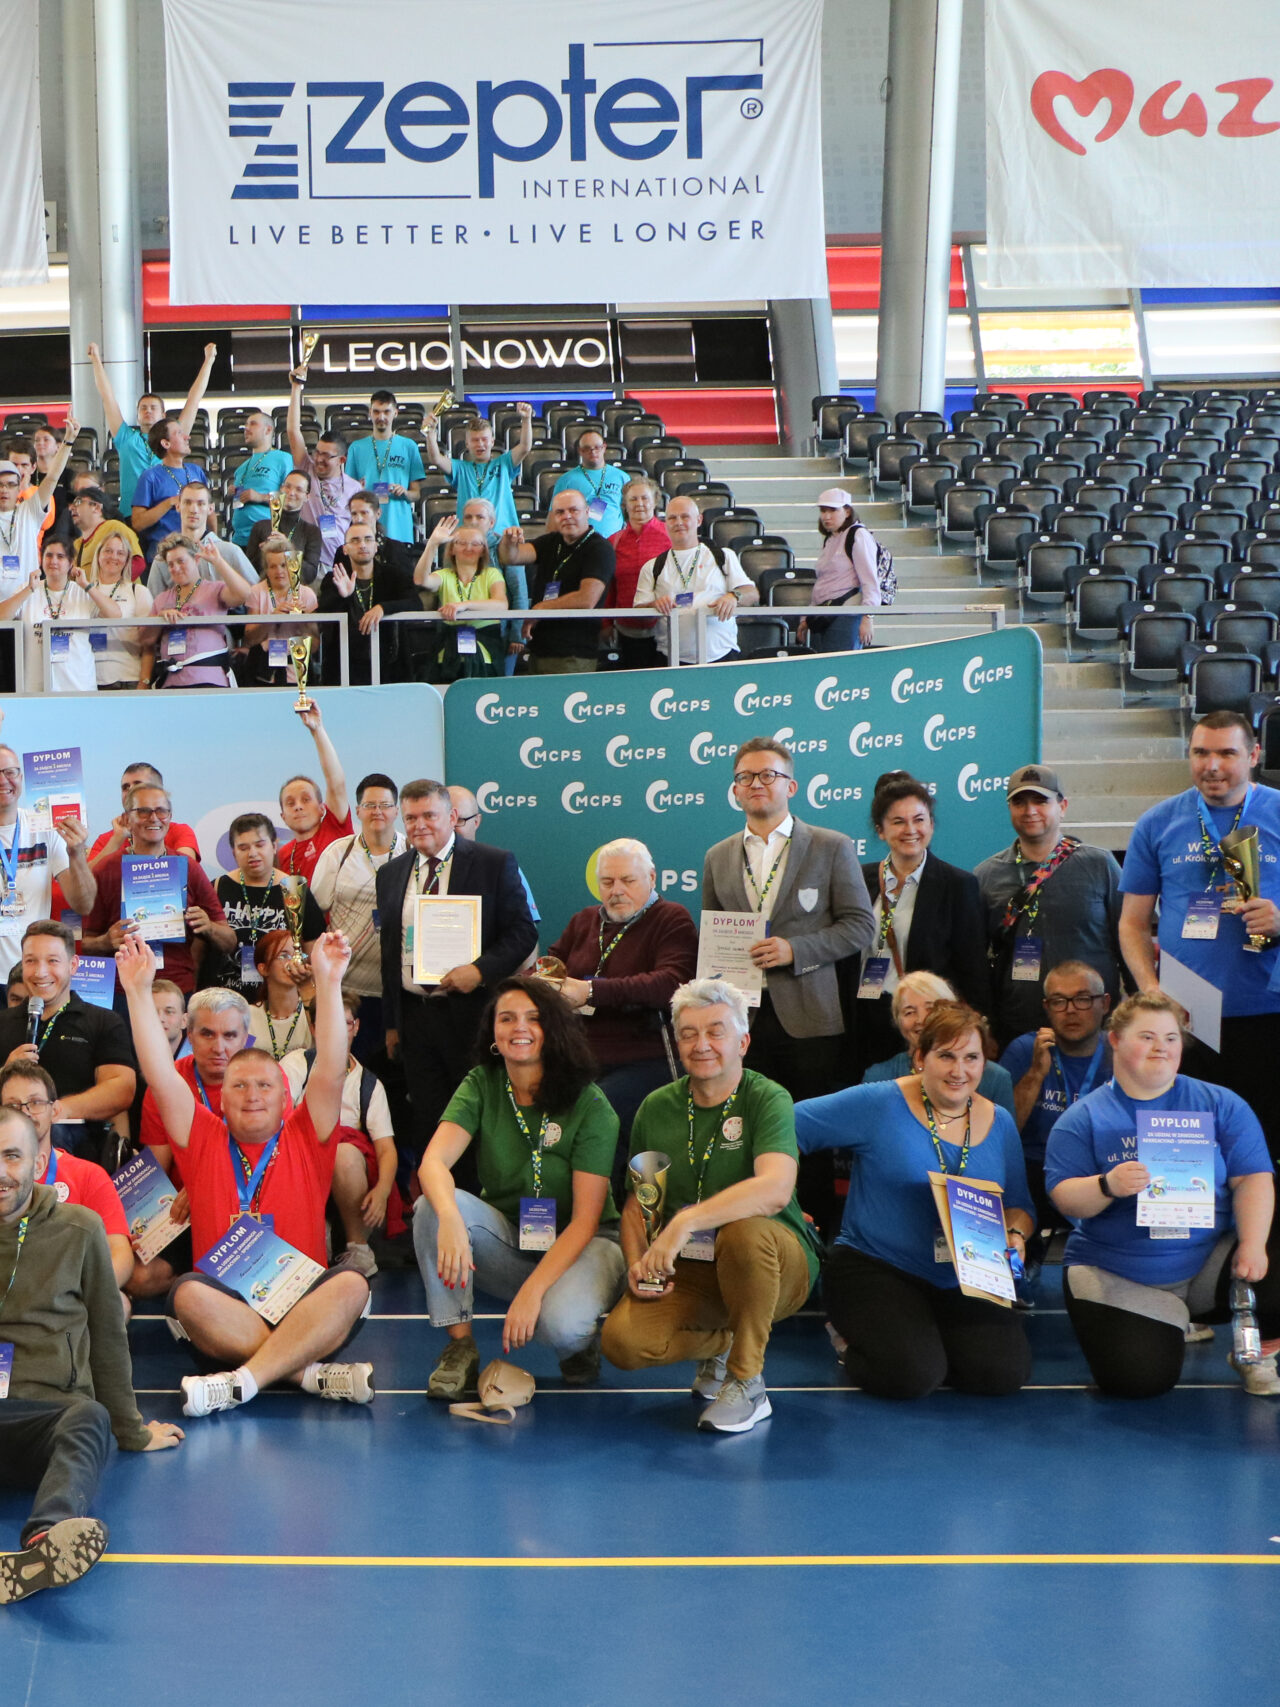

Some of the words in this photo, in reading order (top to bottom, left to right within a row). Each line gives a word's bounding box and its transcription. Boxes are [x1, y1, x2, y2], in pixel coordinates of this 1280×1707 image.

[307, 43, 763, 198] zepter
[522, 175, 765, 199] INTERNATIONAL
[229, 224, 311, 245] LIVE
[331, 223, 469, 245] BETTER
[509, 222, 592, 243] LIVE
[613, 219, 765, 242] LONGER
[323, 338, 607, 373] LEGIONOWO
[974, 665, 1013, 684] MCPS
[903, 678, 943, 695] MCPS
[747, 695, 792, 708] MCPS
[827, 687, 870, 703] MCPS
[491, 706, 538, 718] MCPS
[579, 703, 626, 716] MCPS
[664, 699, 710, 712] MCPS
[935, 725, 976, 741] MCPS
[862, 734, 903, 748] MCPS
[33, 752, 70, 762] DYPLOM
[534, 750, 581, 762] MCPS
[620, 747, 666, 760] MCPS
[659, 793, 704, 805] MCPS
[820, 787, 862, 801] MCPS
[491, 795, 537, 807] MCPS
[576, 795, 621, 807] MCPS
[131, 861, 169, 872] DYPLOM
[223, 901, 286, 923] HAPPY
[713, 917, 755, 927] DYPLOM
[1151, 1117, 1200, 1128] DYPLOM
[956, 1187, 993, 1208] DYPLOM
[209, 1226, 248, 1264] DYPLOM
